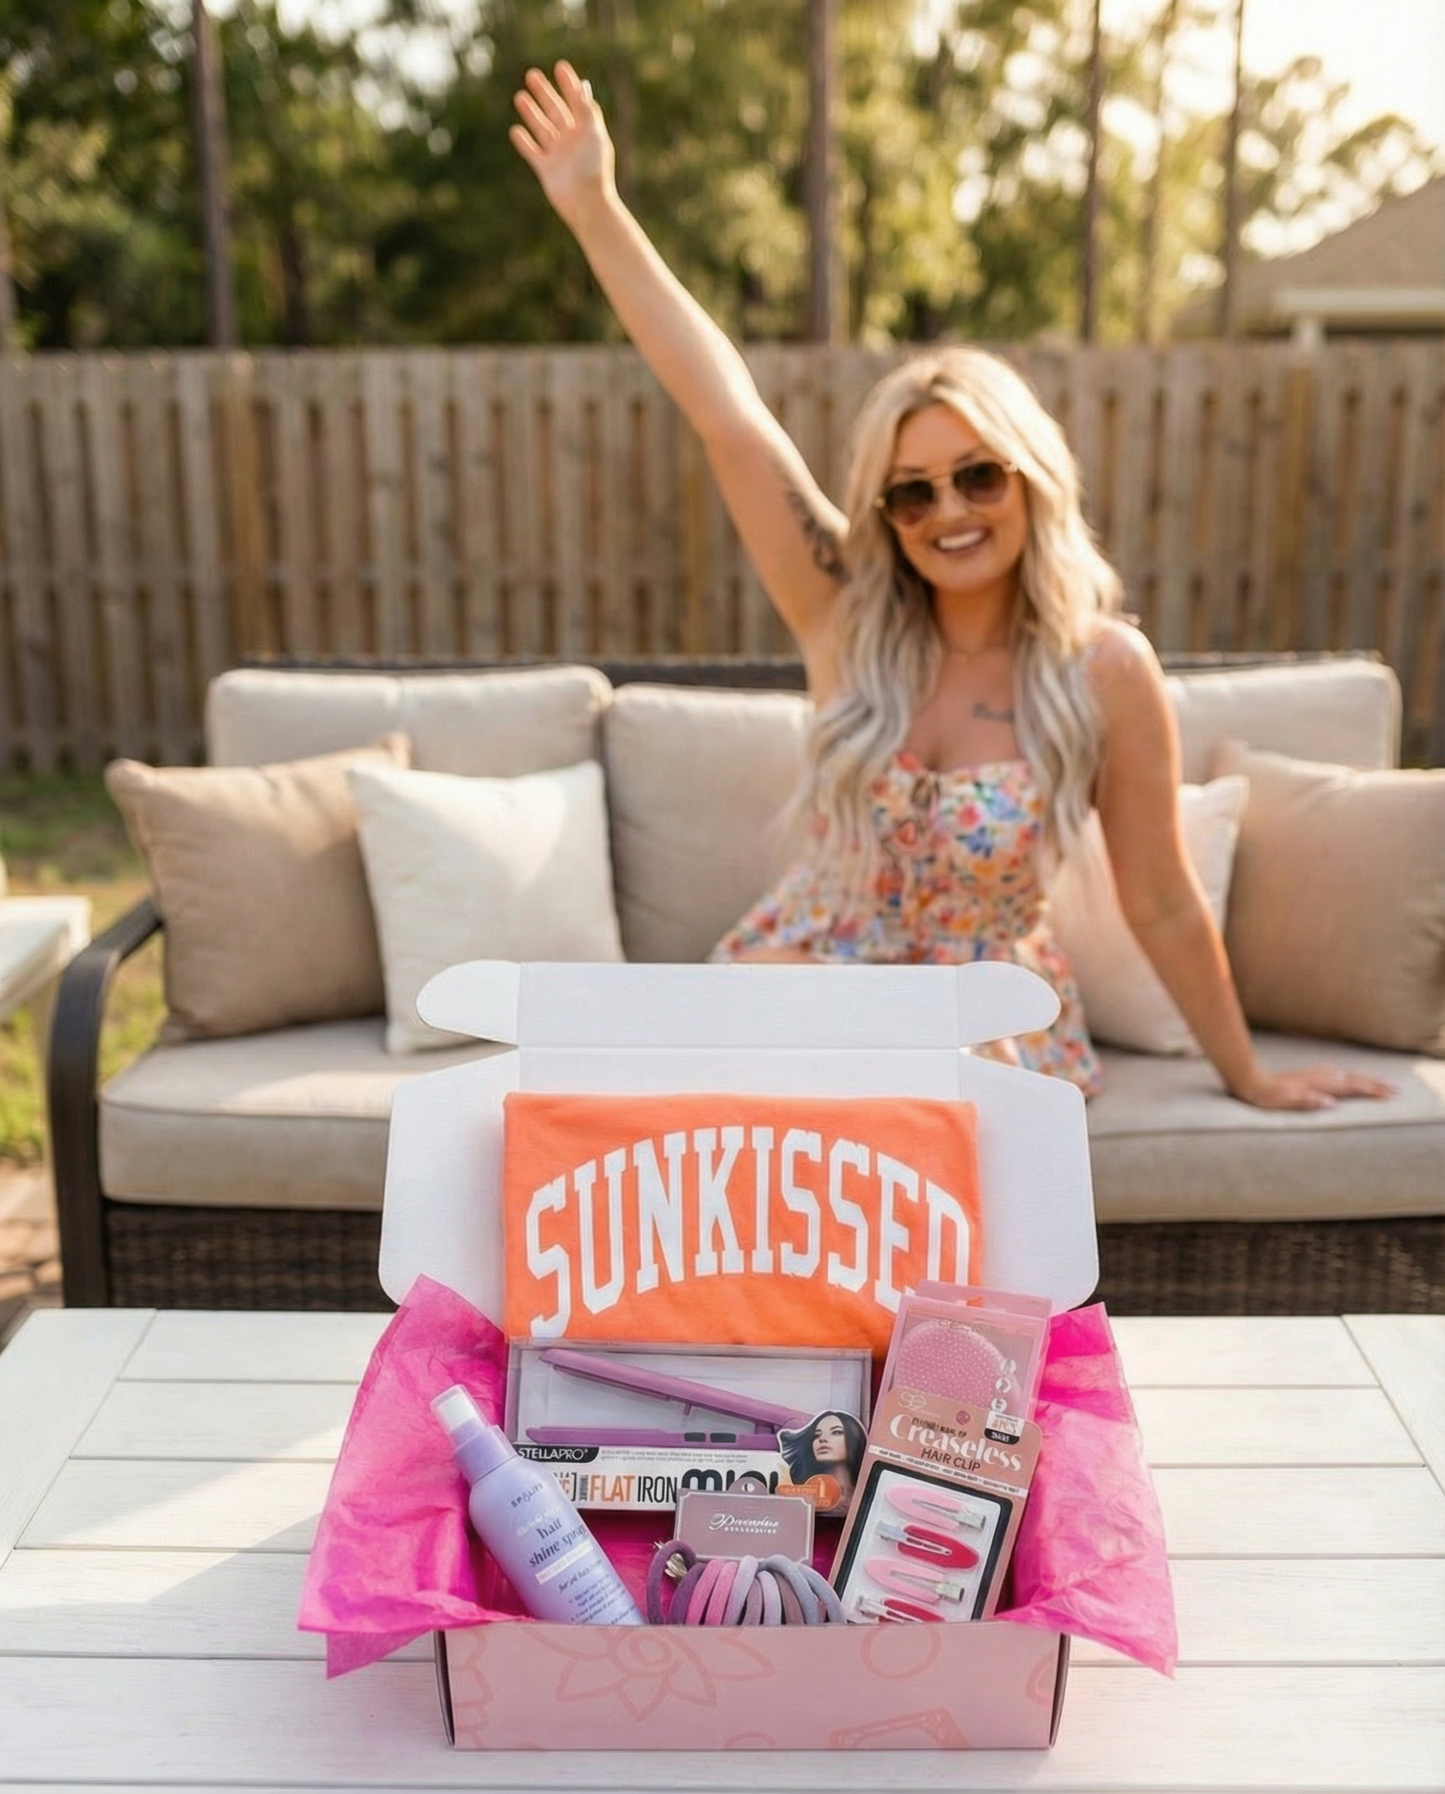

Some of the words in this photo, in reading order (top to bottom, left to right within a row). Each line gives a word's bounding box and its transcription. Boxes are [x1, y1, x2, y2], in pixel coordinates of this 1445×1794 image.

[526, 1126, 970, 1339] SUNKISSED
[518, 1447, 584, 1461] STELLAPRO
[889, 1413, 1022, 1472] Creaseless
[920, 1447, 951, 1466] HAIR
[953, 1456, 981, 1472] CLIP
[590, 1474, 635, 1502] FLAT
[637, 1475, 677, 1503] IRON
[536, 1518, 562, 1540] hair
[528, 1538, 560, 1567] shine
